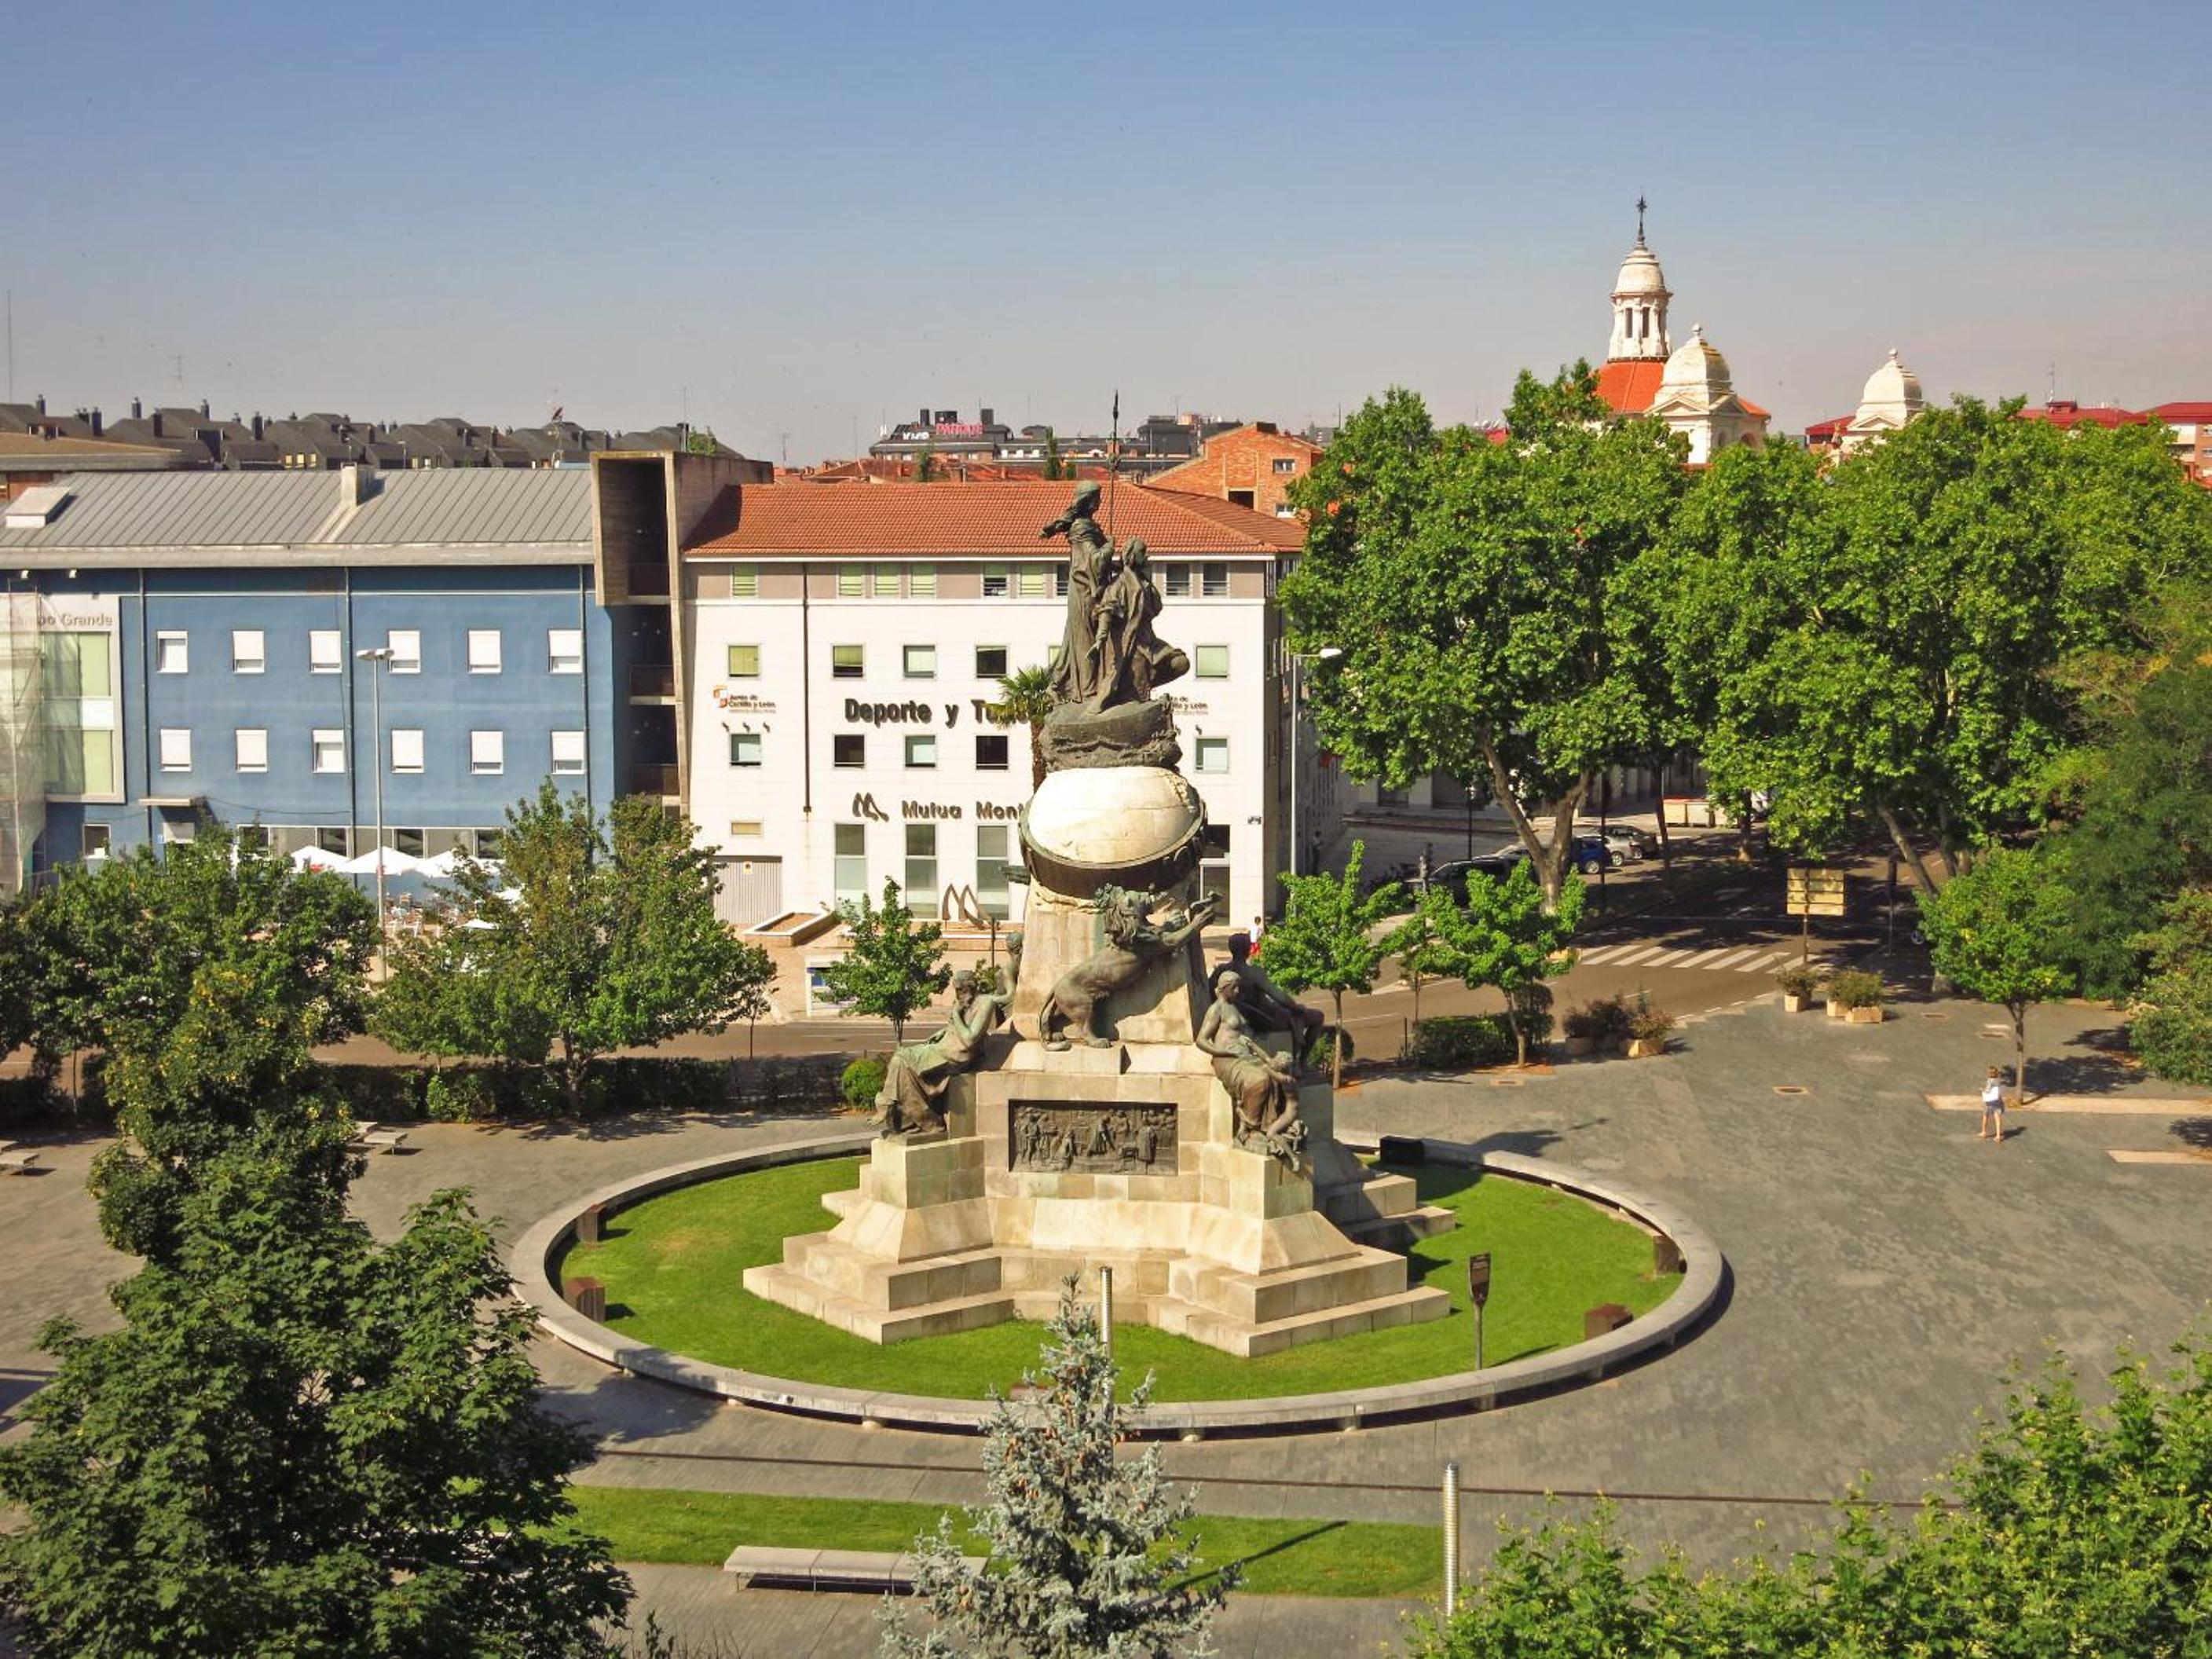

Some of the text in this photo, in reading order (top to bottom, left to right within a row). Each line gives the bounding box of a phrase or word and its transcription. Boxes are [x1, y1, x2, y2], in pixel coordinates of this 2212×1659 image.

[61, 613, 113, 626] Grande
[844, 698, 933, 728] Deporte
[944, 704, 959, 729] y
[902, 800, 962, 819] Mutua
[976, 800, 1024, 820] Mont
